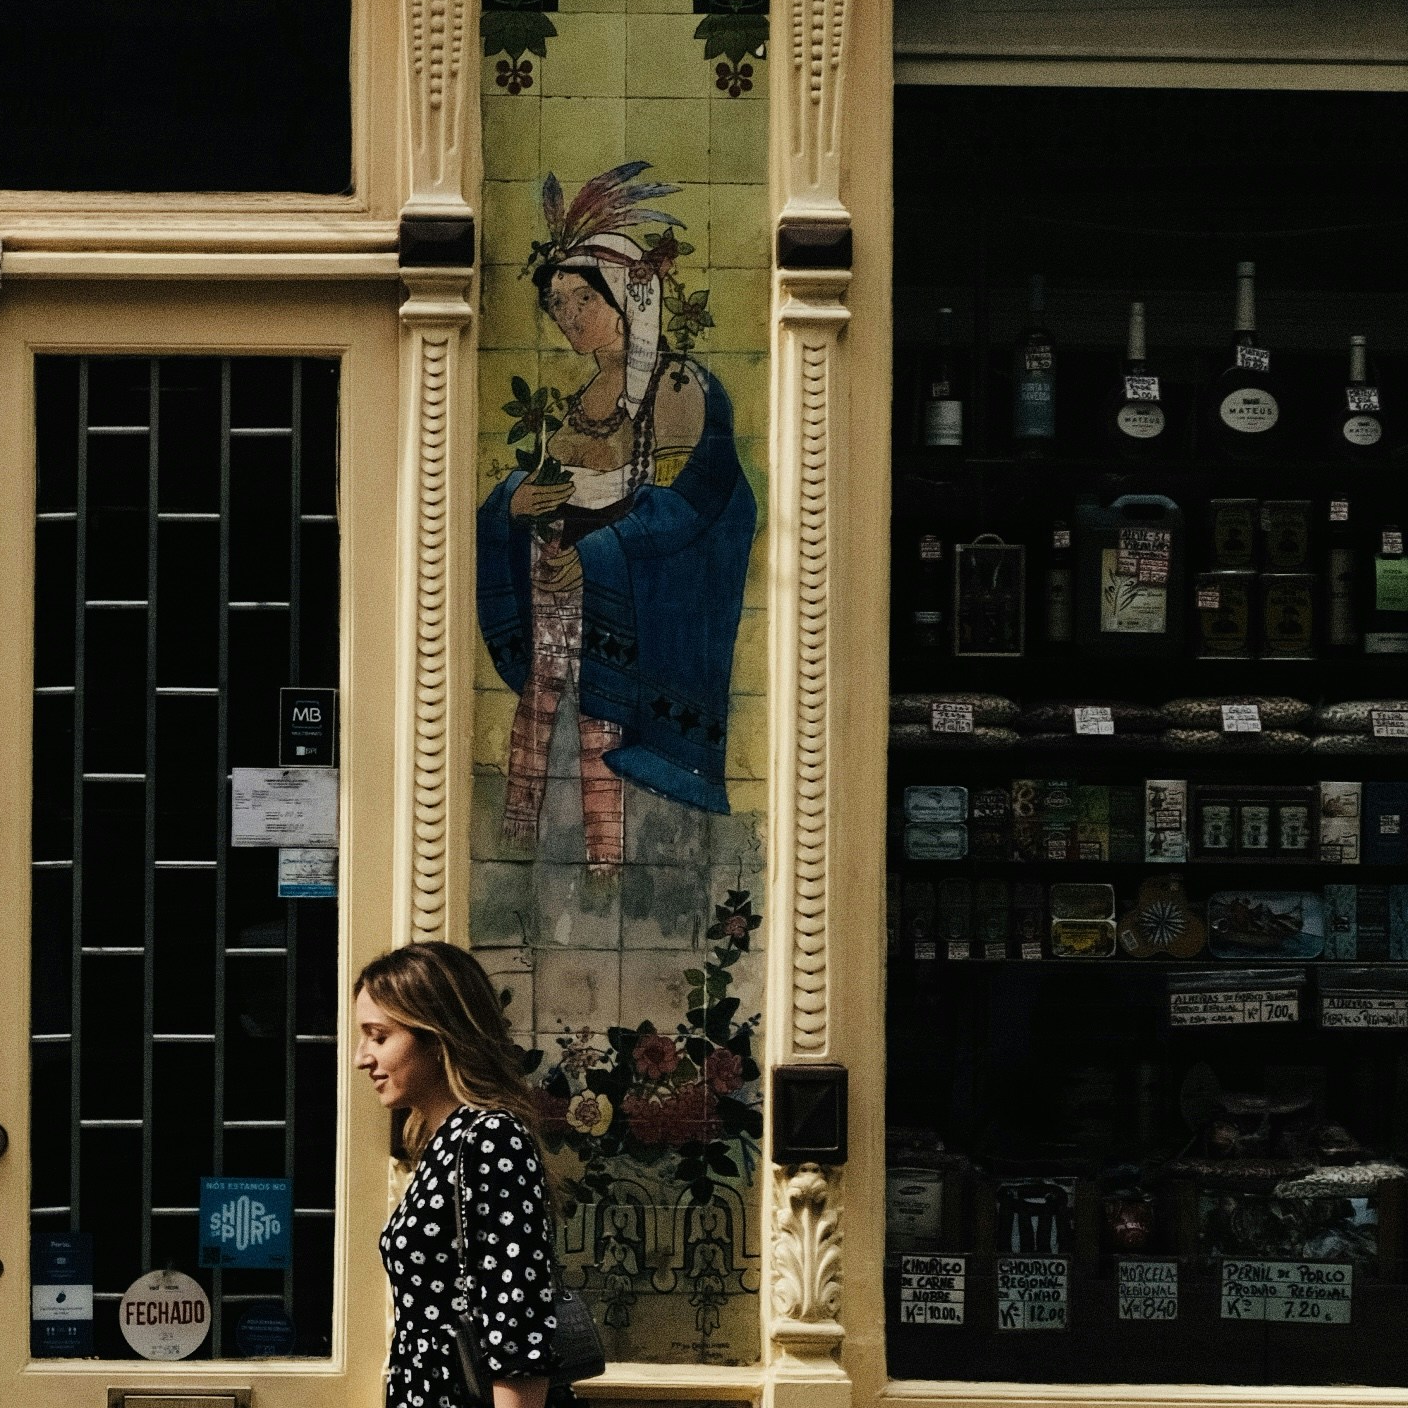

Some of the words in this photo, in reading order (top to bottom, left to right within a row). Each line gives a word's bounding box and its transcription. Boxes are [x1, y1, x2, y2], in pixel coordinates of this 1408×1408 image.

[1229, 407, 1273, 415] MATEUS
[292, 707, 322, 722] MB
[1174, 994, 1219, 1005] ALHEIRAS
[272, 1183, 287, 1191] NO
[903, 1258, 962, 1276] CHOURIÇO
[1120, 1264, 1176, 1284] MORCELA
[1224, 1263, 1273, 1282] PERNIL
[1297, 1264, 1345, 1284] PORCO
[917, 1277, 955, 1290] CARNE
[1119, 1283, 1176, 1299] REGIONAL
[912, 1290, 951, 1303] NOBRE
[1017, 1288, 1062, 1302] VINHO
[1287, 1283, 1349, 1300] REGIONAL
[126, 1300, 205, 1325] FECHADO
